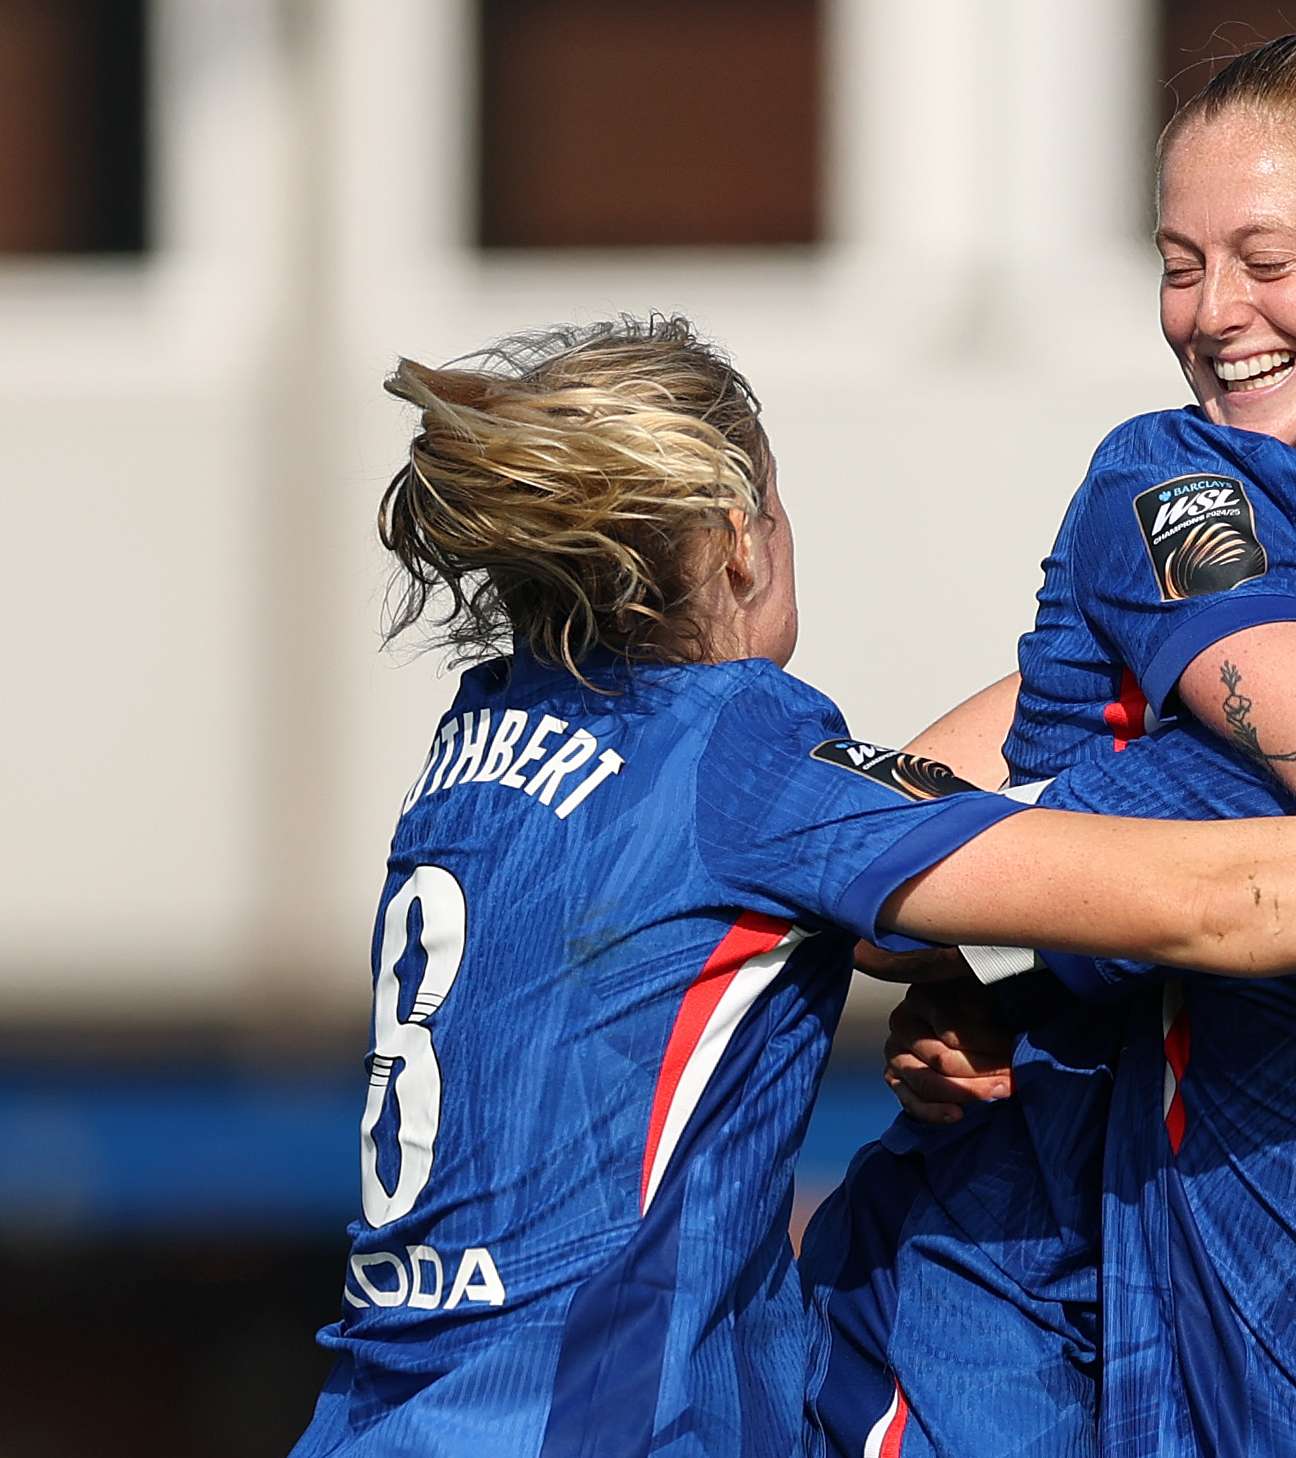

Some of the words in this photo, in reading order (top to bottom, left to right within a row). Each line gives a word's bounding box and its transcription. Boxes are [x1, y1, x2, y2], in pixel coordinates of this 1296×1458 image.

[1152, 489, 1240, 536] WSL
[1174, 480, 1232, 496] BARCLAYS
[1153, 514, 1205, 545] CHAMPIONS
[402, 708, 625, 819] UTHBERT
[360, 865, 467, 1229] 8
[344, 1244, 506, 1310] ODA
